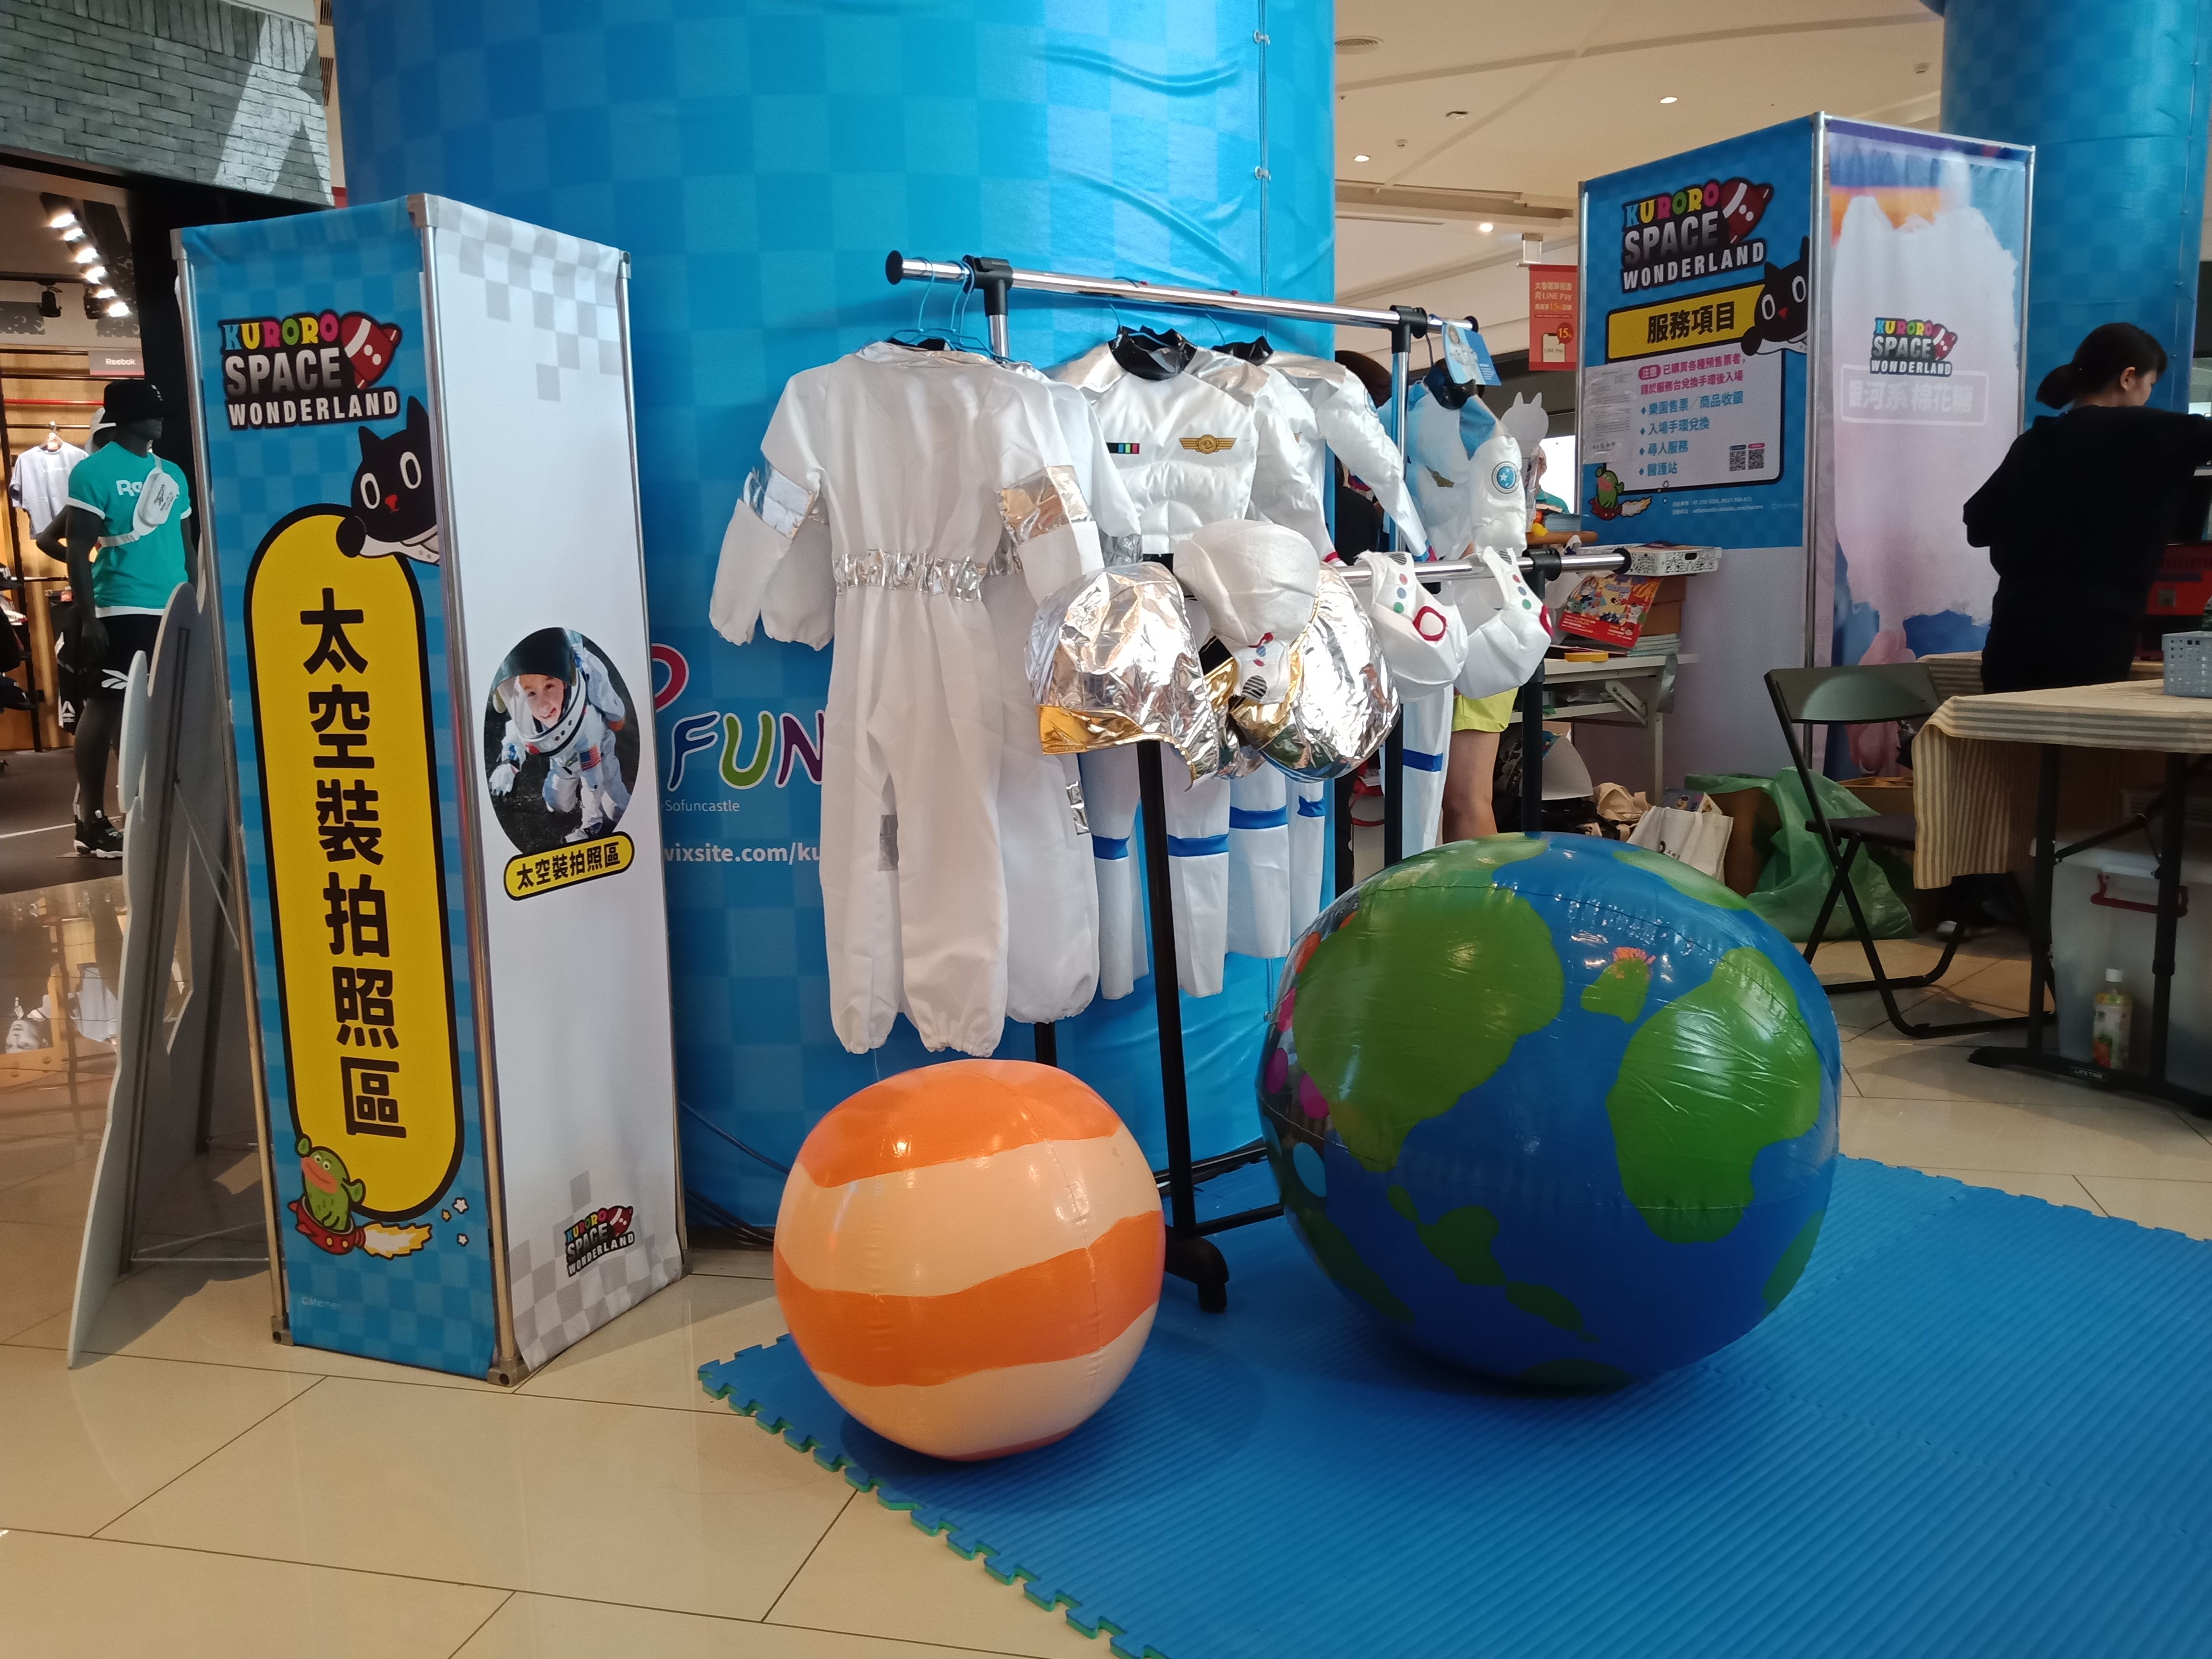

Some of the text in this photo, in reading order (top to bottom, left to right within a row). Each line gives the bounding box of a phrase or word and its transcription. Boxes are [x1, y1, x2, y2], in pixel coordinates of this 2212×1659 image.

[1625, 182, 1719, 228] KURORO
[1624, 210, 1719, 264] SPACE
[1623, 241, 1765, 290] WONDERLAND
[223, 313, 339, 350] KURORO
[1647, 301, 1735, 344] 服務項目
[1875, 320, 1933, 336] KURORO
[105, 358, 136, 366] Reebok
[1873, 336, 1933, 359] SPACE
[225, 347, 342, 396] SPACE
[1871, 360, 1951, 375] WONDERLAND
[228, 390, 398, 426] WONDERLAND
[1647, 440, 1689, 456] 尋人服務
[666, 709, 825, 792] FUN
[665, 799, 740, 812] Sofuncastle
[299, 587, 407, 1139] 太空裝拍照區
[516, 841, 621, 890] 太空裝拍照區
[565, 1209, 607, 1242] KURORO
[567, 1222, 608, 1261] SPACE
[568, 1233, 634, 1275] WONDERLAND
